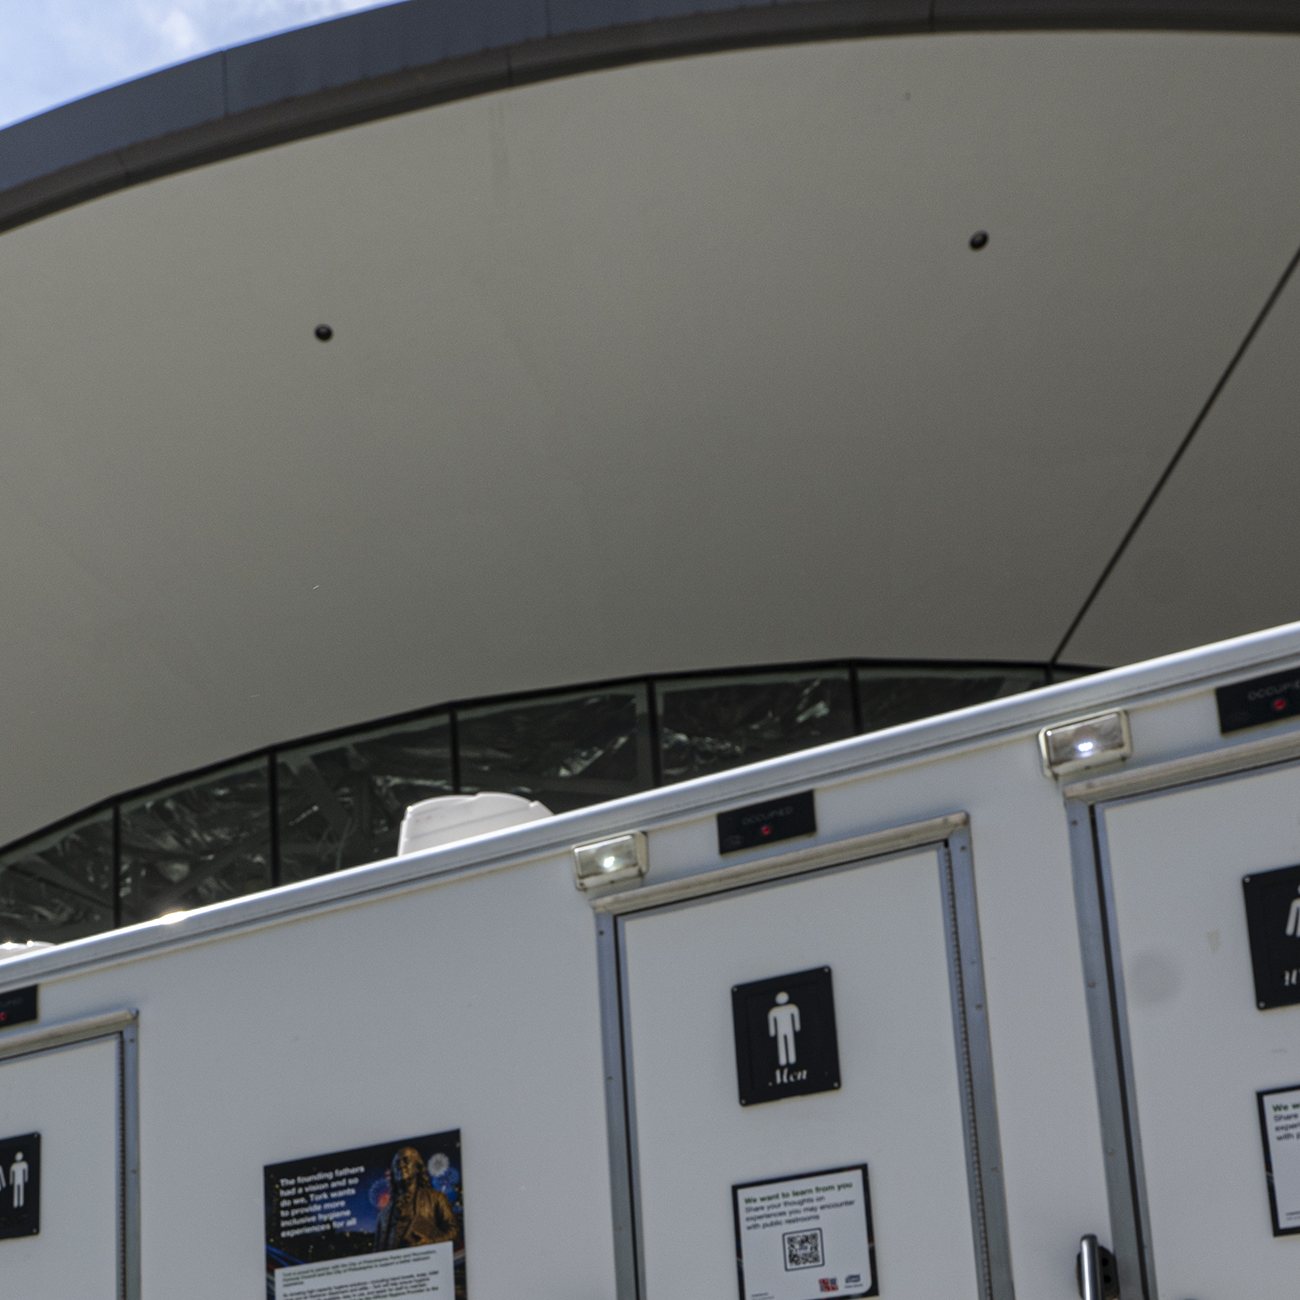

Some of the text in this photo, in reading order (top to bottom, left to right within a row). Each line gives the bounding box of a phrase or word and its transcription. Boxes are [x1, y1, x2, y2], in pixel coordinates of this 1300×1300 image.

[775, 1067, 807, 1085] Men
[1272, 1104, 1289, 1112] We
[279, 1165, 365, 1187] The founding fathers
[279, 1187, 296, 1197] had
[304, 1182, 329, 1193] vision
[330, 1178, 347, 1188] and
[279, 1199, 292, 1208] do
[309, 1191, 329, 1202] Tork
[329, 1187, 356, 1198] wants
[279, 1200, 346, 1217] to provide more
[280, 1209, 352, 1228] inclusive hygiene
[280, 1217, 357, 1238] experiences for all
